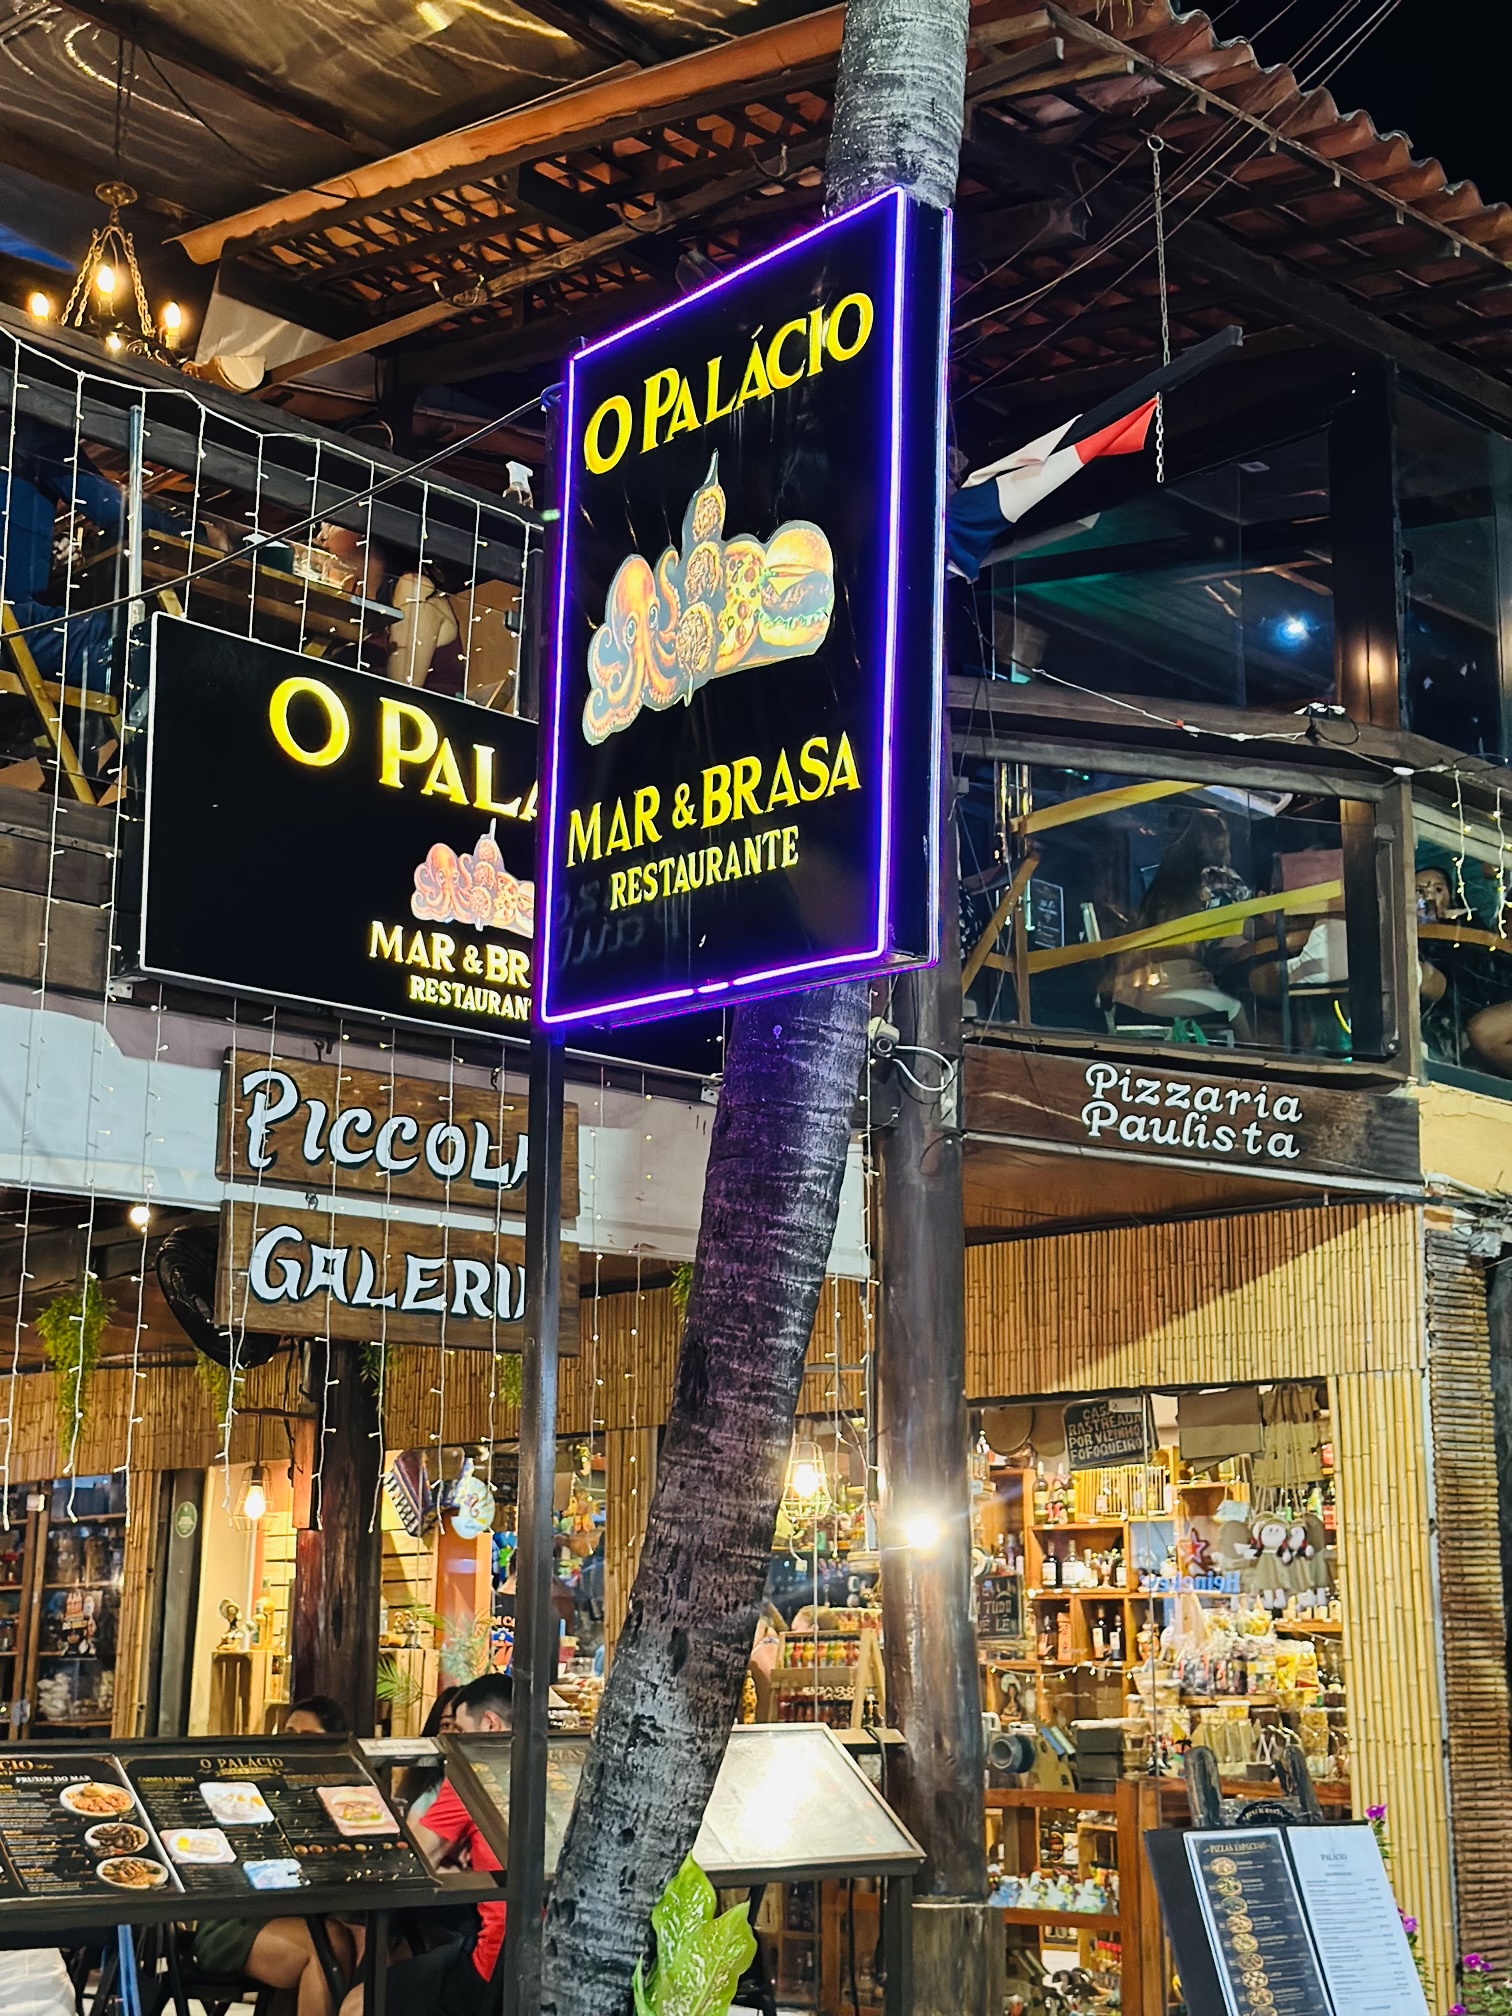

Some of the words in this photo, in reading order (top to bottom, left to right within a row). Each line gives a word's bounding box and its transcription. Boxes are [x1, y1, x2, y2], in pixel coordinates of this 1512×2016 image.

[585, 394, 632, 475] O
[640, 292, 874, 454] PALÁCIO
[269, 676, 350, 767] O
[566, 785, 663, 868] MAR
[672, 782, 697, 829] &
[701, 731, 862, 829] BRASA
[610, 825, 799, 911] RESTAURANTE
[370, 921, 456, 973] MAR
[463, 944, 483, 975] &
[409, 974, 533, 1021] RESTAURAN
[1085, 1063, 1303, 1123] Pizzaria
[1082, 1101, 1300, 1159] Paulista
[1083, 1404, 1109, 1420] CAS
[1068, 1434, 1093, 1449] POR
[200, 1759, 212, 1769] O
[217, 1755, 284, 1769] PALÁCIO
